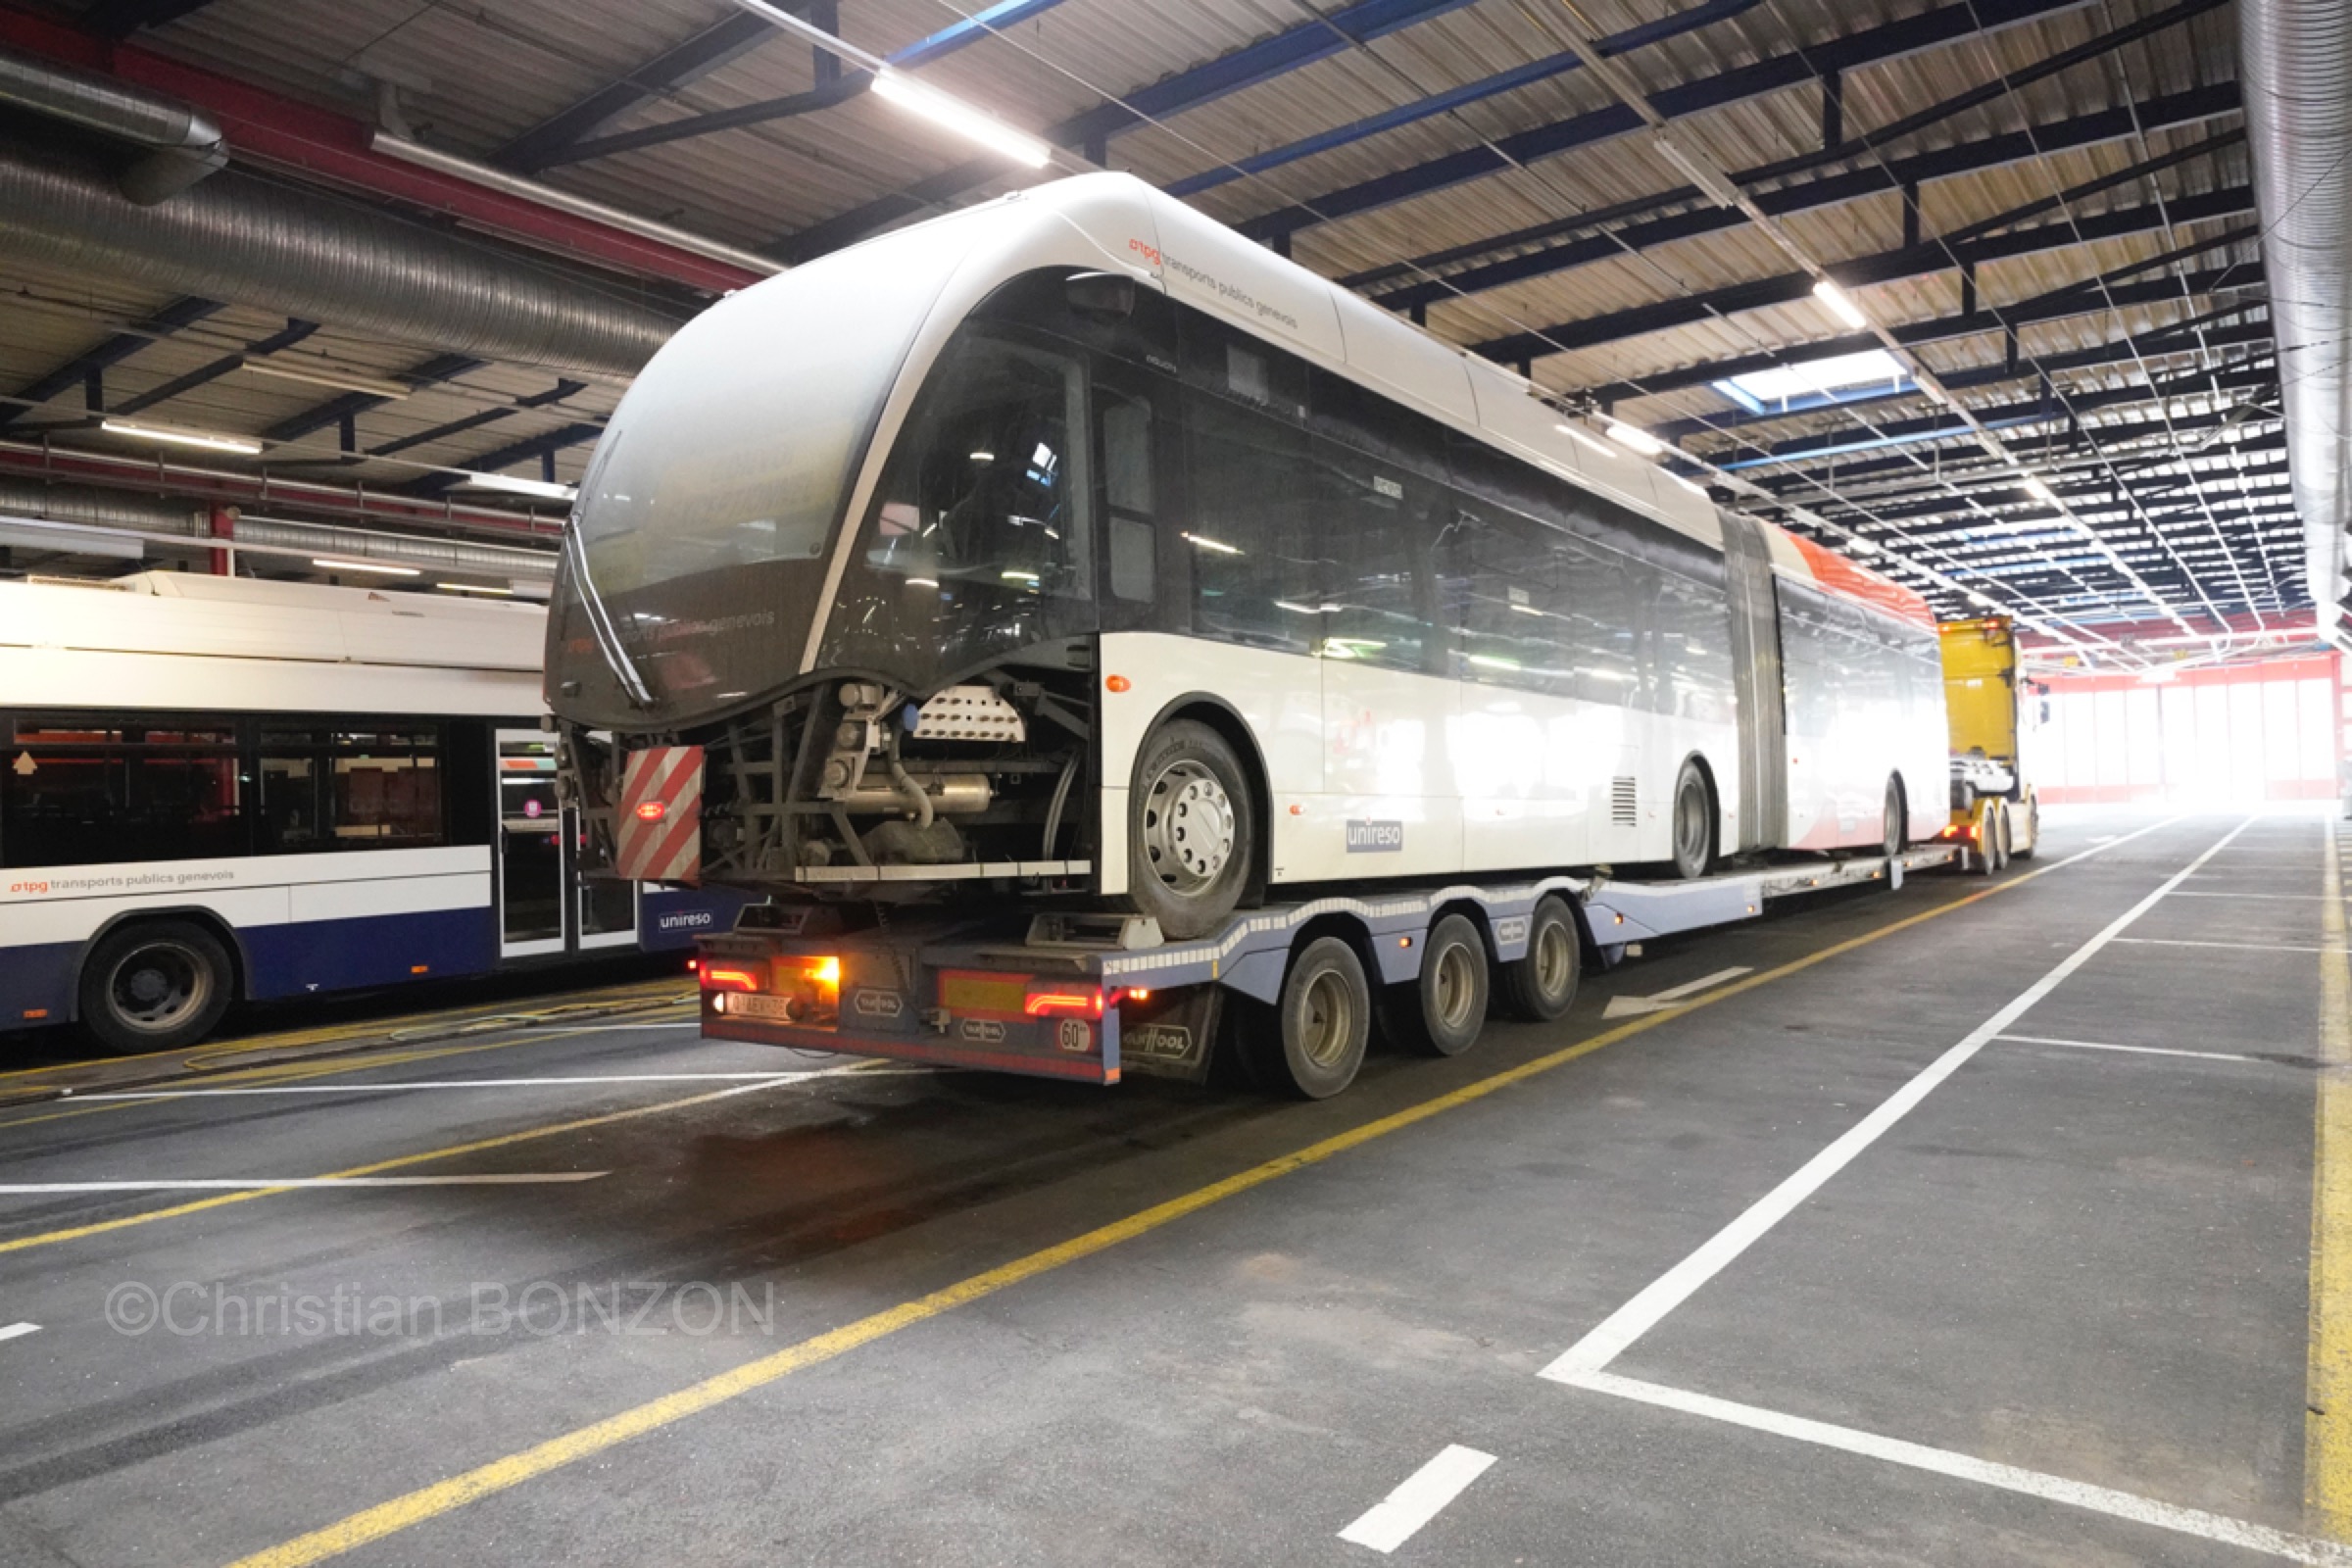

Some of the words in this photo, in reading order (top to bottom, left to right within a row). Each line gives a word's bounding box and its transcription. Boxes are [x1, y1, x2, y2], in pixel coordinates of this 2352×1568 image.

[1162, 252, 1216, 290] transports
[1218, 281, 1254, 308] publics
[1255, 301, 1298, 330] genevois
[1348, 820, 1401, 846] unireso
[50, 876, 123, 891] transports
[125, 873, 174, 888] publics
[176, 869, 234, 884] genevois
[660, 911, 710, 928] unireso
[1061, 1022, 1079, 1048] 60
